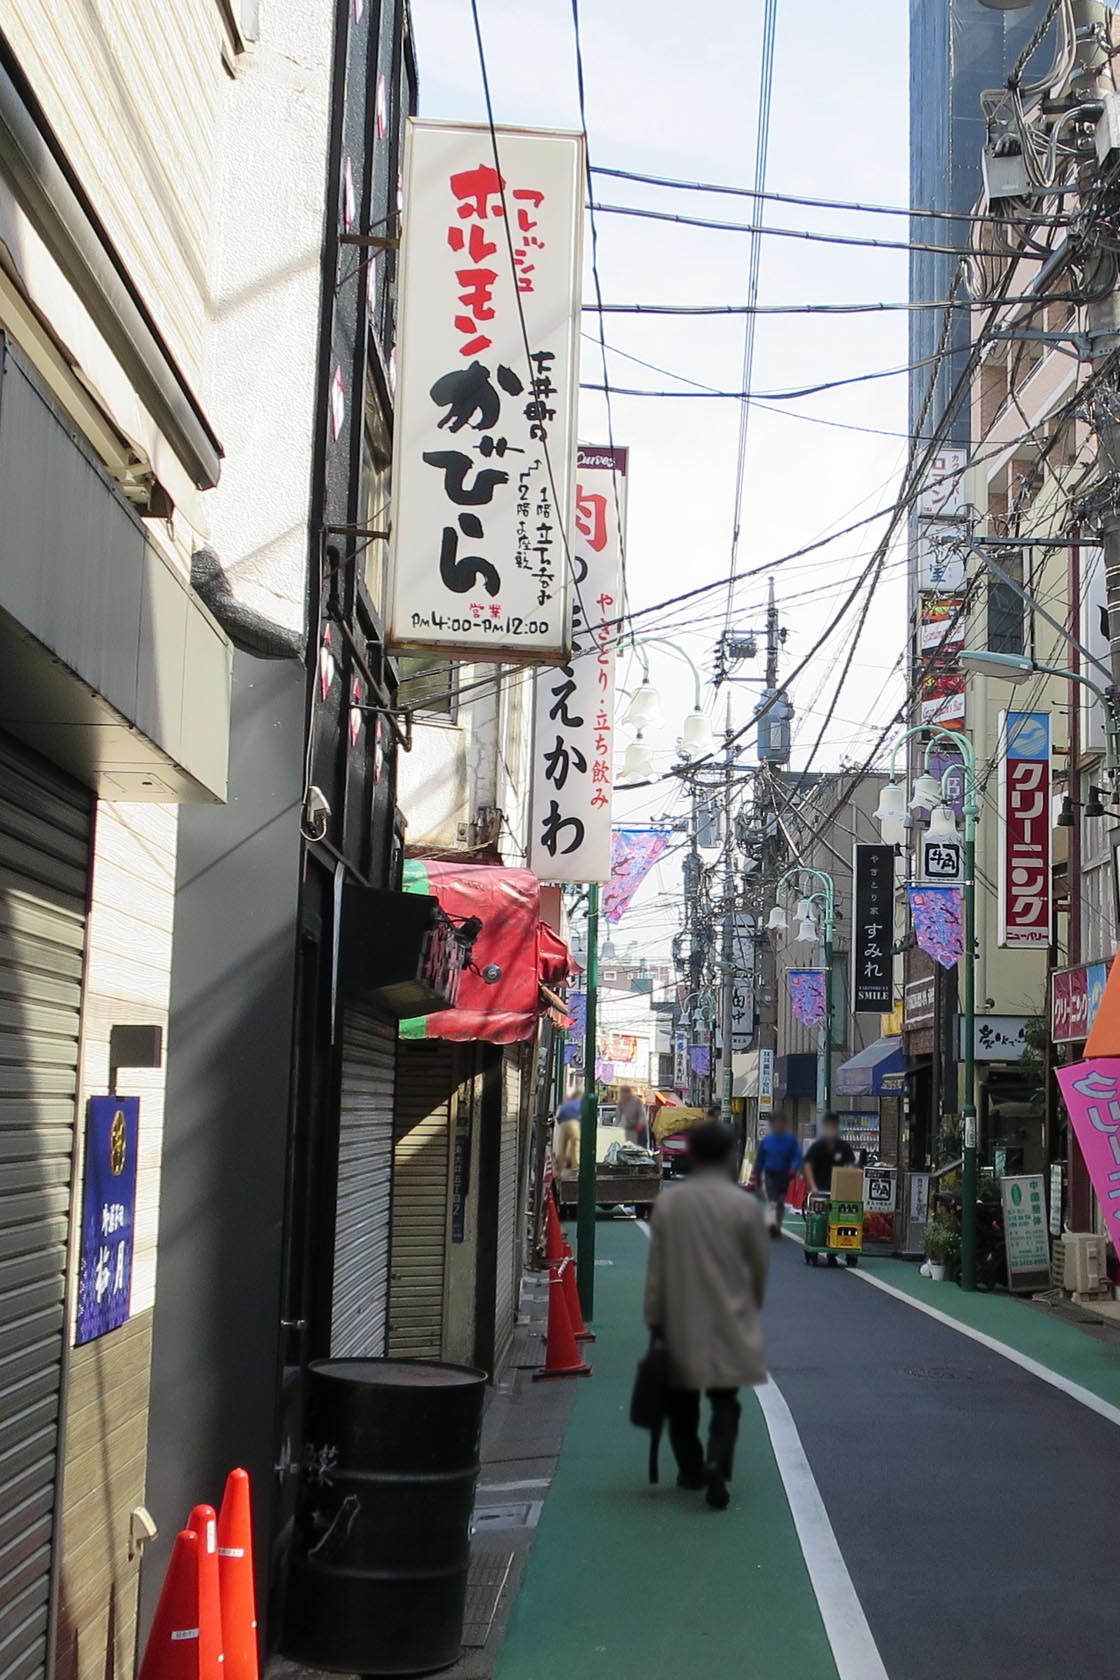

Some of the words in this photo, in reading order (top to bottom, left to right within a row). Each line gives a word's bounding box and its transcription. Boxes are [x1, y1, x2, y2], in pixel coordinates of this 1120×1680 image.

[447, 163, 507, 356] ホルモン
[512, 188, 546, 293] フレッシュ
[930, 849, 956, 870] 牛角
[1012, 763, 1048, 924] クリーニング
[864, 923, 883, 978] すみれ
[858, 991, 889, 1000] SMILE
